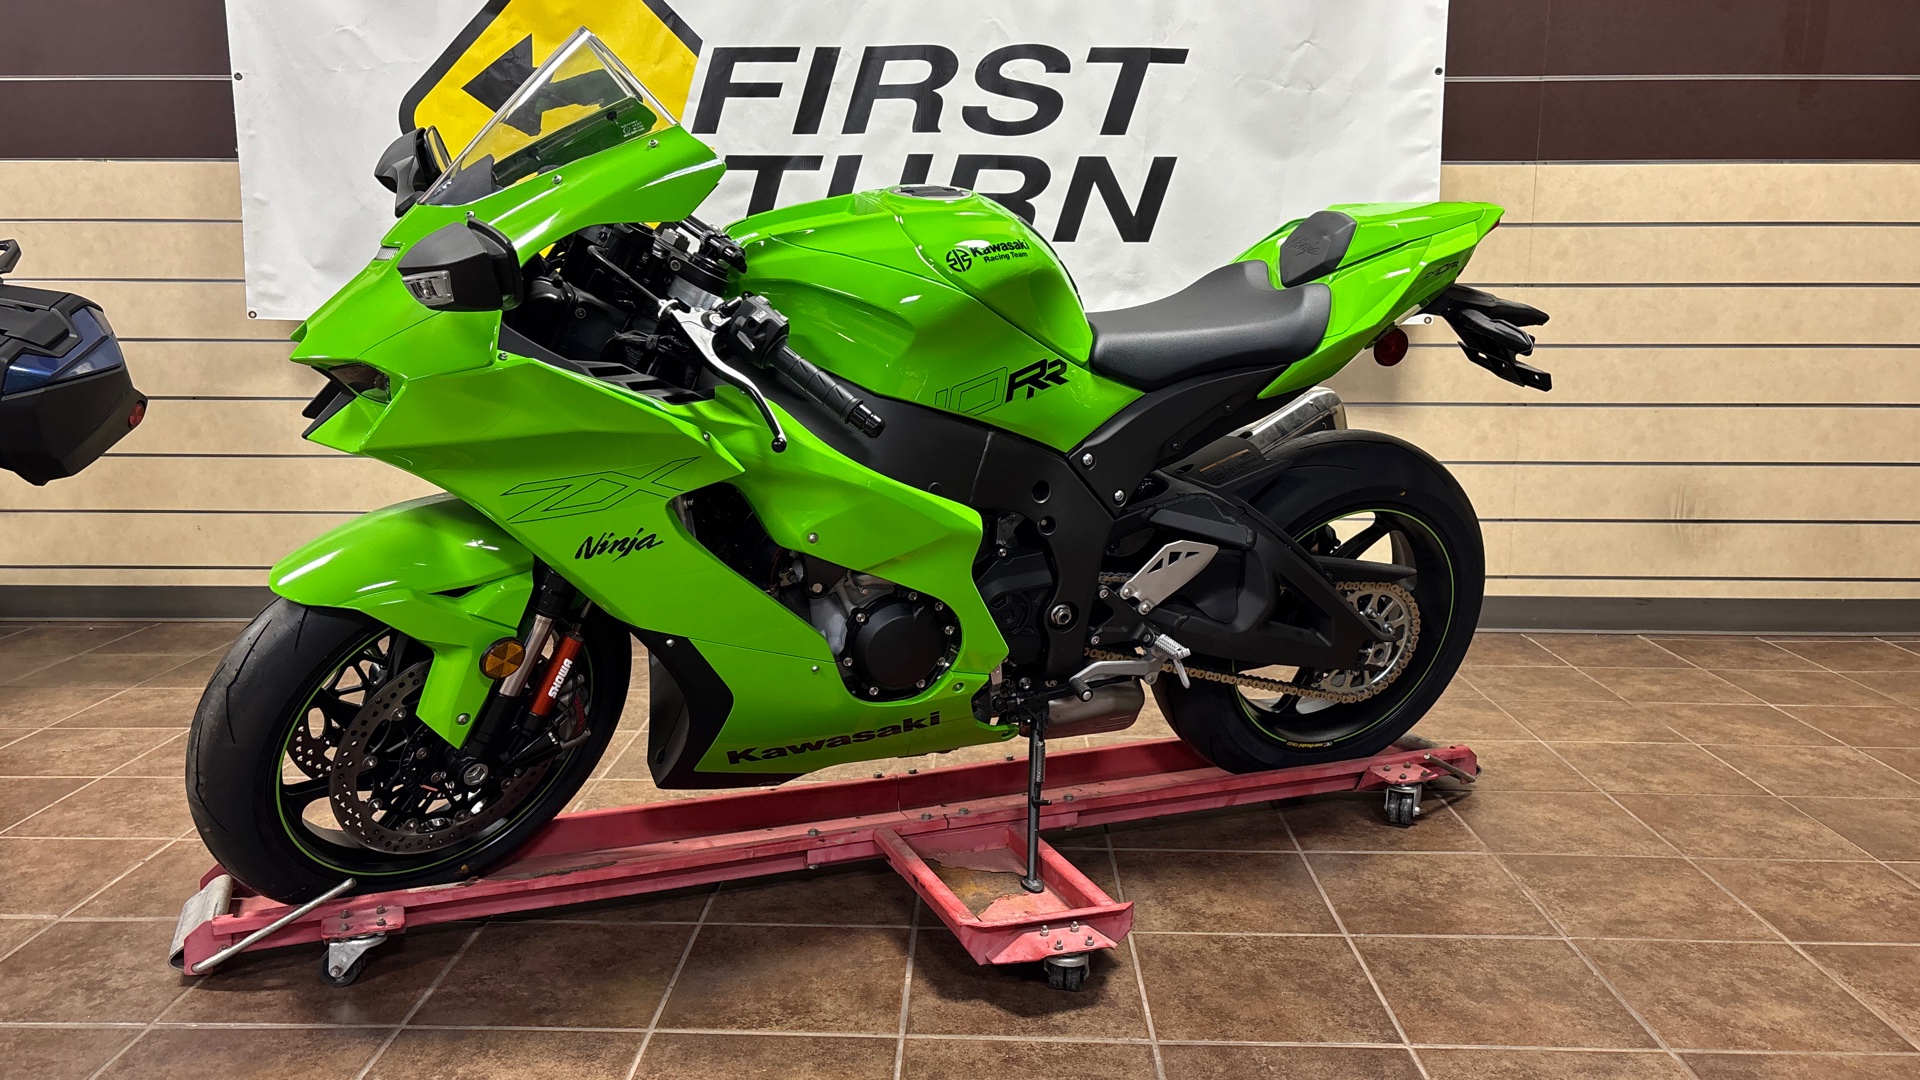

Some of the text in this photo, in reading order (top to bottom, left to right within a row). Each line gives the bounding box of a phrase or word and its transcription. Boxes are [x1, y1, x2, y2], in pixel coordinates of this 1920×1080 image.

[691, 44, 1190, 136] FIRST
[969, 239, 1030, 258] Kawasaki
[983, 251, 1029, 263] Racing Team
[574, 528, 664, 562] Ninja
[548, 658, 573, 699] SHOWA
[727, 711, 940, 765] Kawasaki
